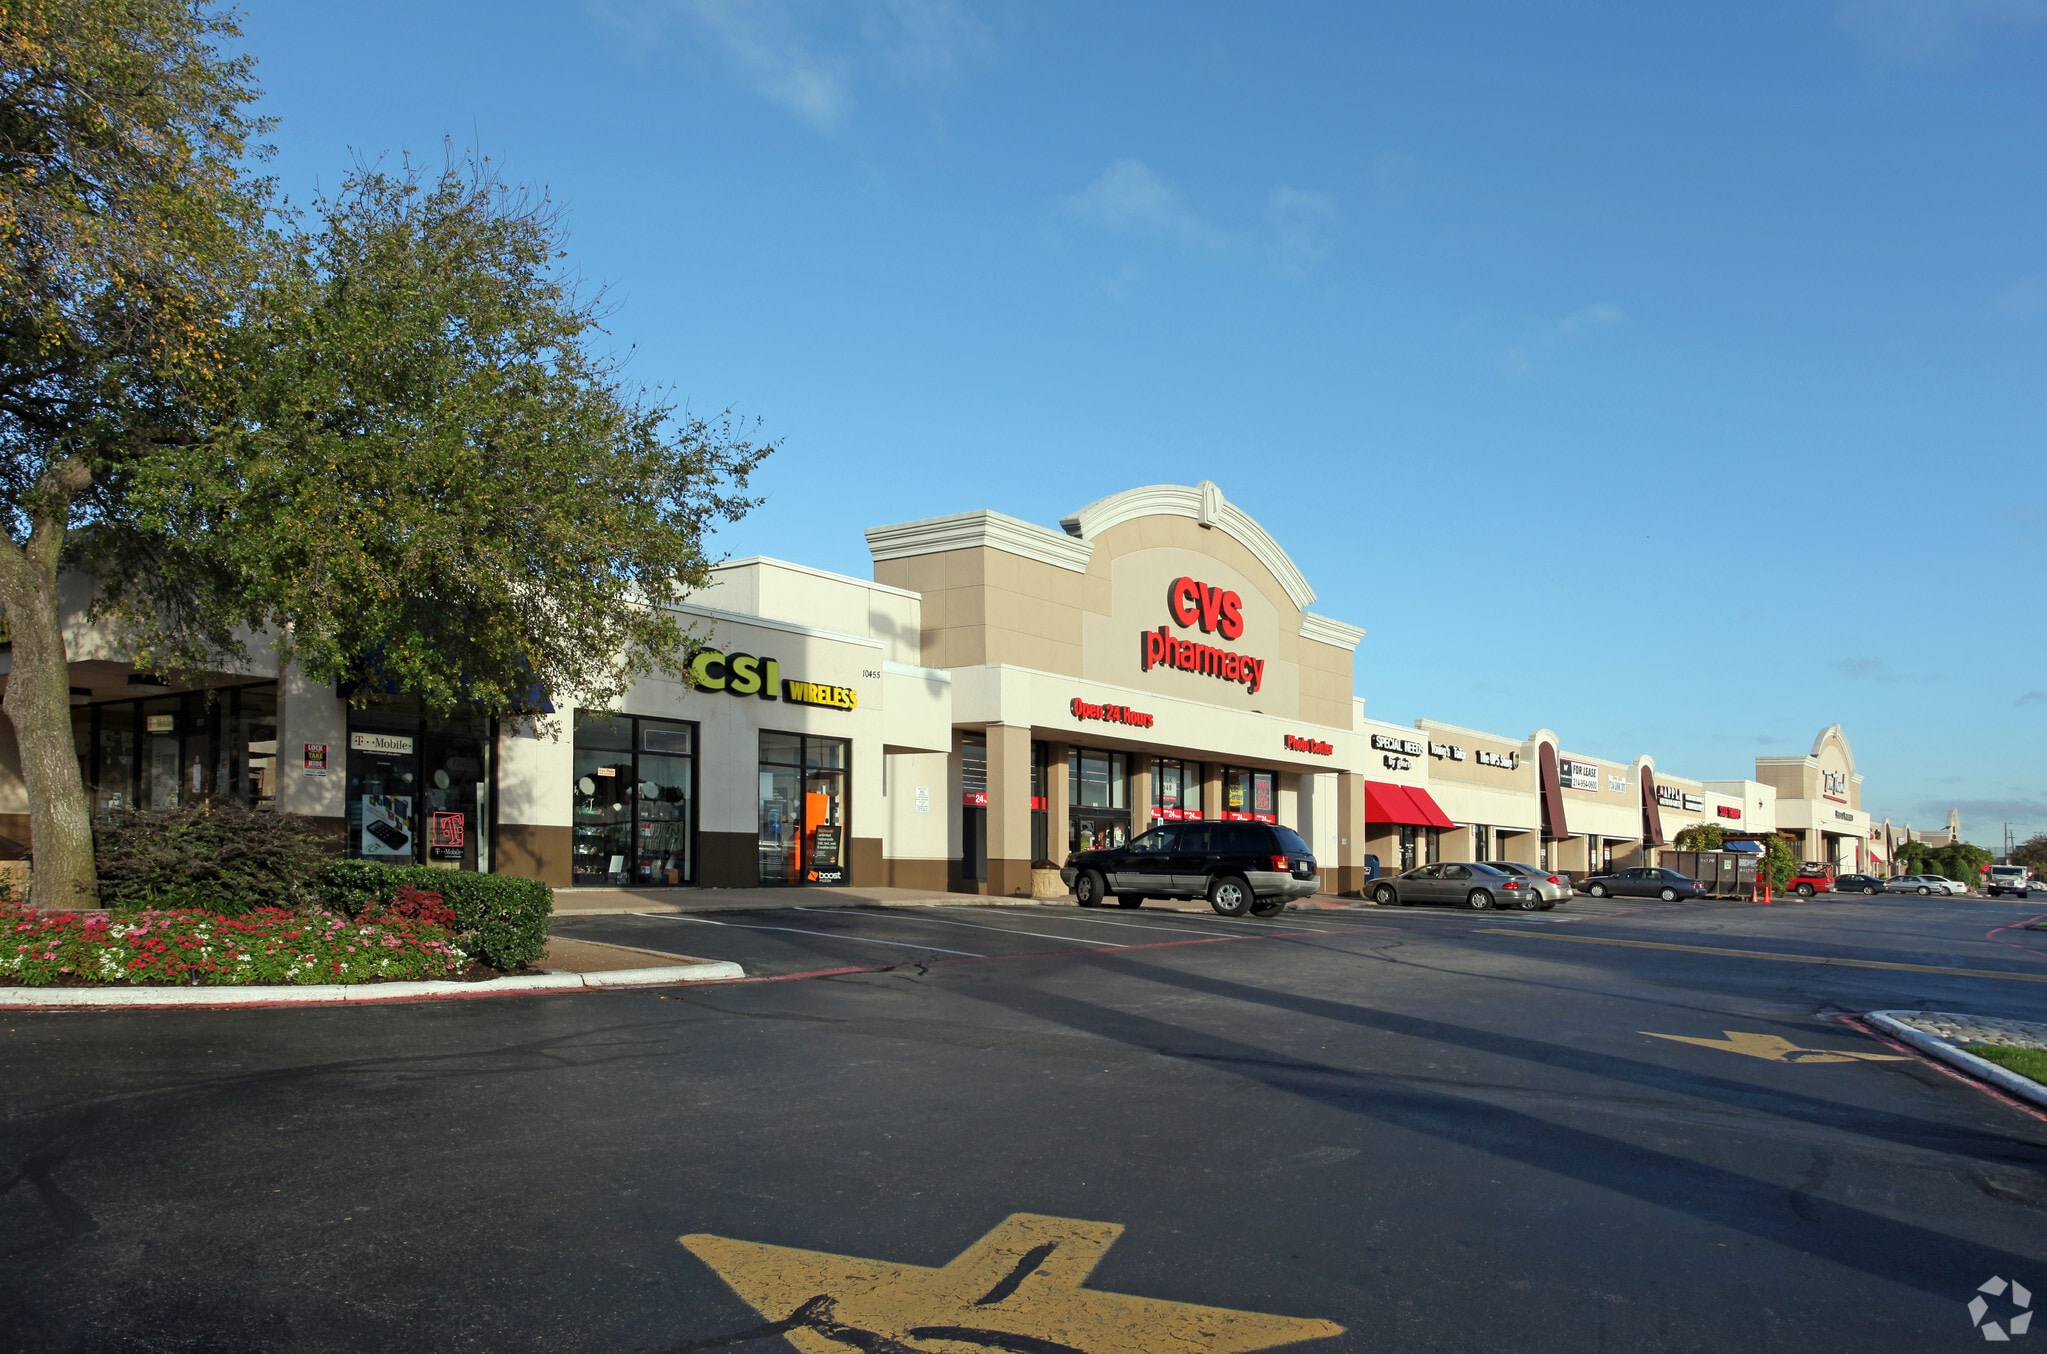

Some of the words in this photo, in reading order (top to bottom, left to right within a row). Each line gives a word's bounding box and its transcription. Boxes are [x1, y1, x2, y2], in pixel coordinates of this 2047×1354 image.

[1170, 576, 1244, 640] CVS
[1144, 625, 1264, 693] pharmacy
[690, 650, 780, 698] CSI
[788, 680, 858, 708] WIRELESS
[862, 669, 881, 680] 10455
[1072, 697, 1103, 720] Open
[1105, 703, 1121, 721] 24
[1122, 705, 1154, 728] Hours
[1286, 735, 1309, 752] Photo
[1310, 738, 1334, 756] Center
[1375, 736, 1403, 751] SPECIAL
[1404, 741, 1423, 755] NEEDS
[1479, 751, 1489, 763] The
[1573, 764, 1583, 775] FOR
[1583, 767, 1597, 778] LEASE
[975, 795, 984, 803] 24
[819, 871, 841, 879] boost
